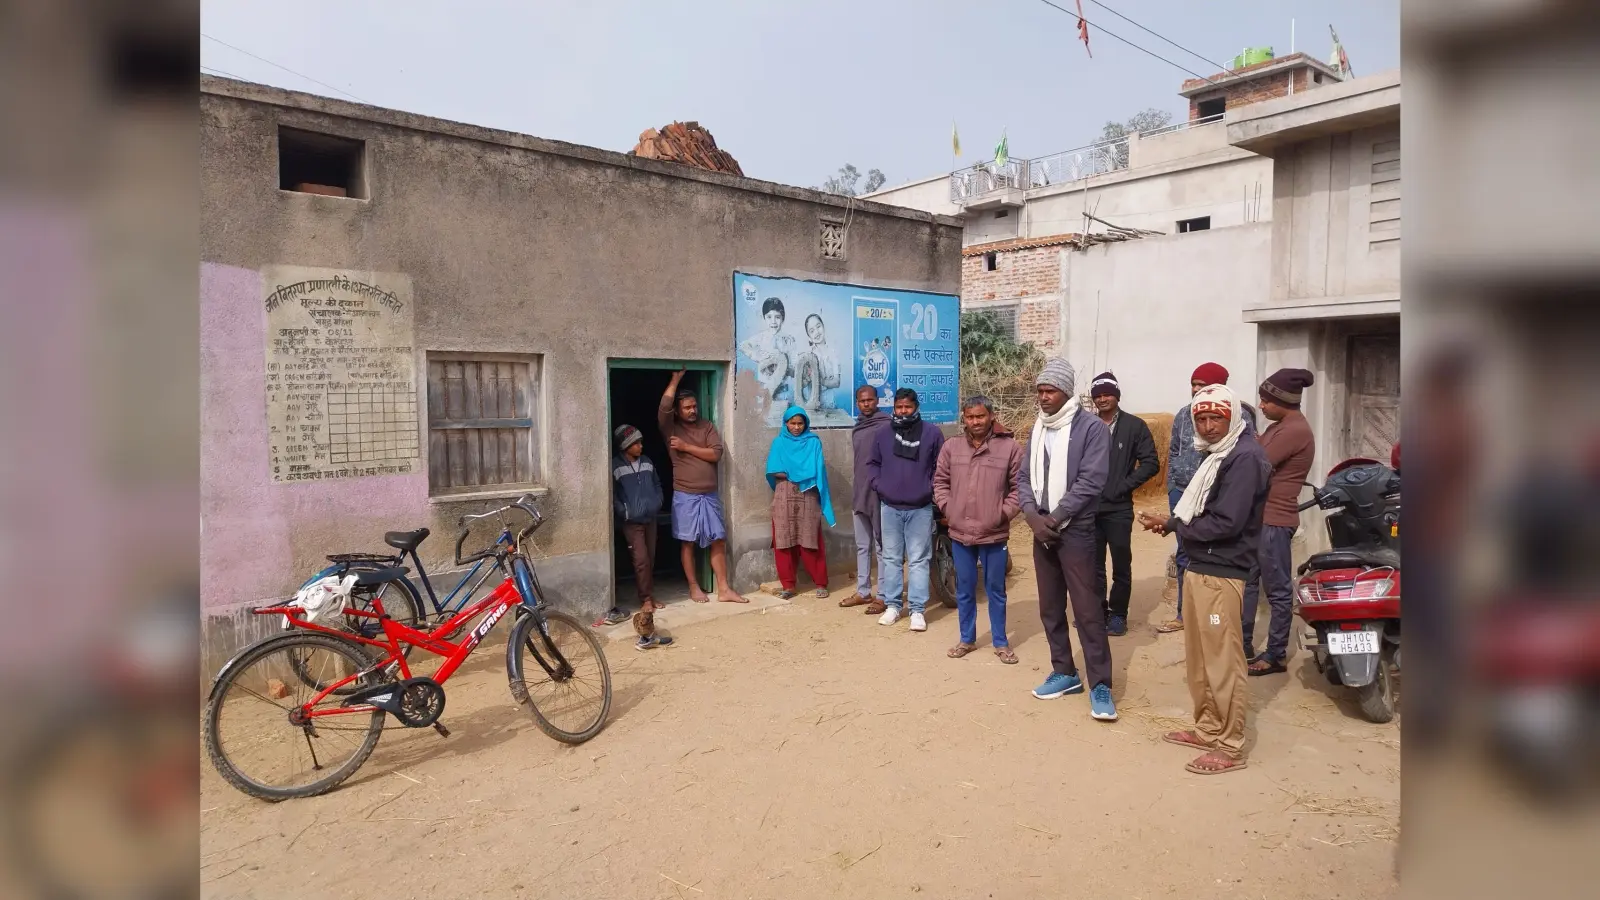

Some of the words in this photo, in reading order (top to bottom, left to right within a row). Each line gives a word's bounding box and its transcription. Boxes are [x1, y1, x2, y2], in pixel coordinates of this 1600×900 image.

[939, 328, 952, 341] का
[902, 344, 921, 361] सर्फ
[924, 346, 954, 363] एक्सेल
[867, 358, 886, 372] Surf
[929, 371, 954, 387] सफाई
[479, 602, 508, 636] GANG
[1340, 633, 1371, 643] JH10C
[1340, 643, 1373, 653] H5433
